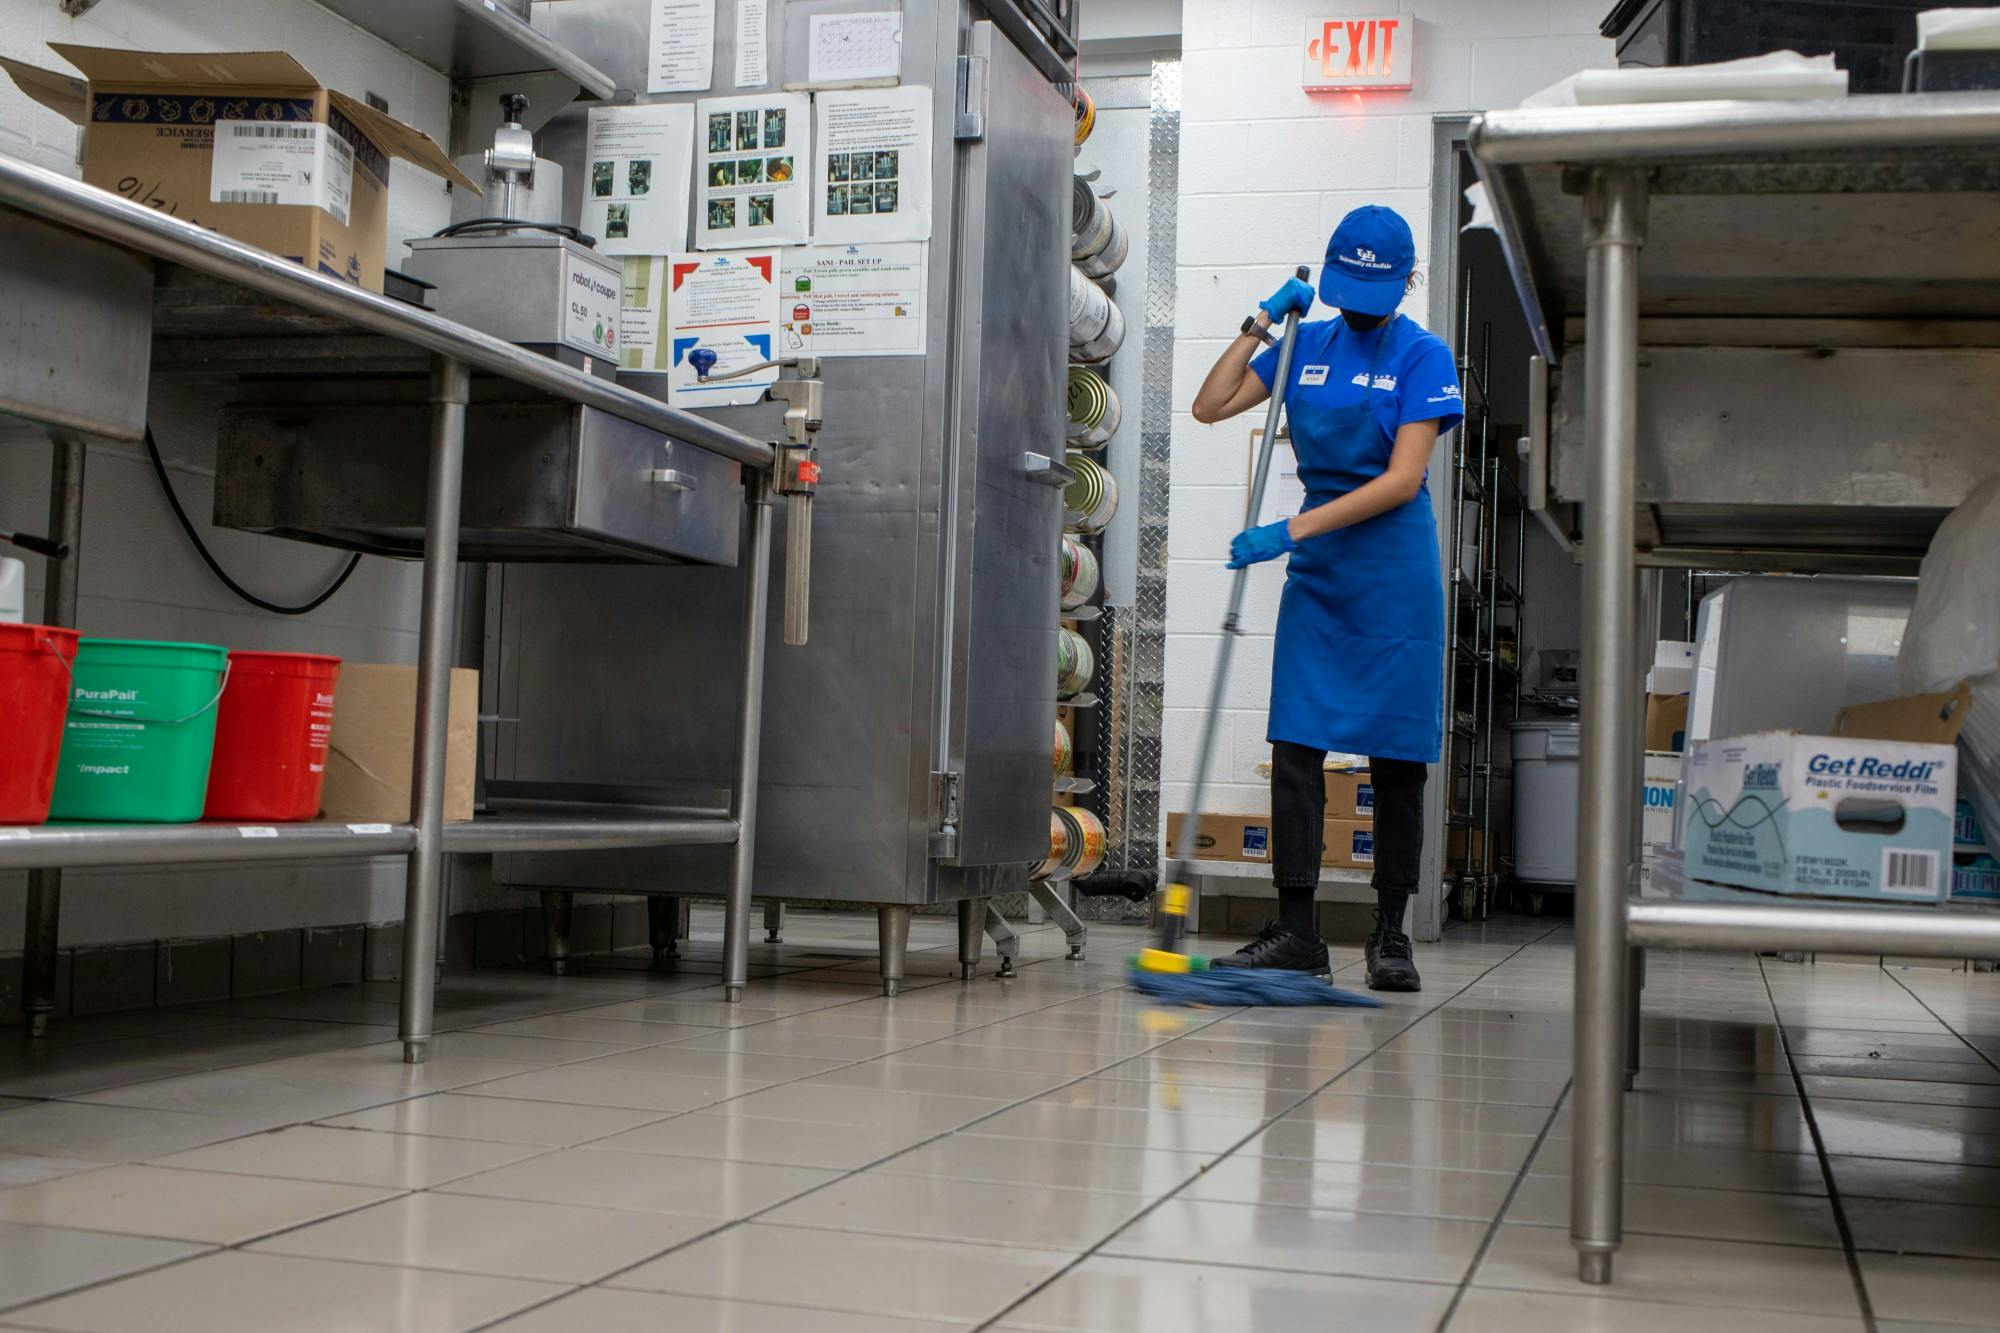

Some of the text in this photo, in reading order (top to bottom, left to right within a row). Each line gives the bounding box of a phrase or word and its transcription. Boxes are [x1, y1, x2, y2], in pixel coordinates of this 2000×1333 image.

[1322, 20, 1399, 77] EXIT
[573, 272, 591, 288] robot
[596, 284, 616, 300] coupe
[572, 302, 580, 314] CL
[580, 306, 588, 318] 50
[76, 688, 136, 700] PuraPail
[1809, 754, 1856, 774] Get
[1805, 776, 1938, 794] Plastic Foodservice Film
